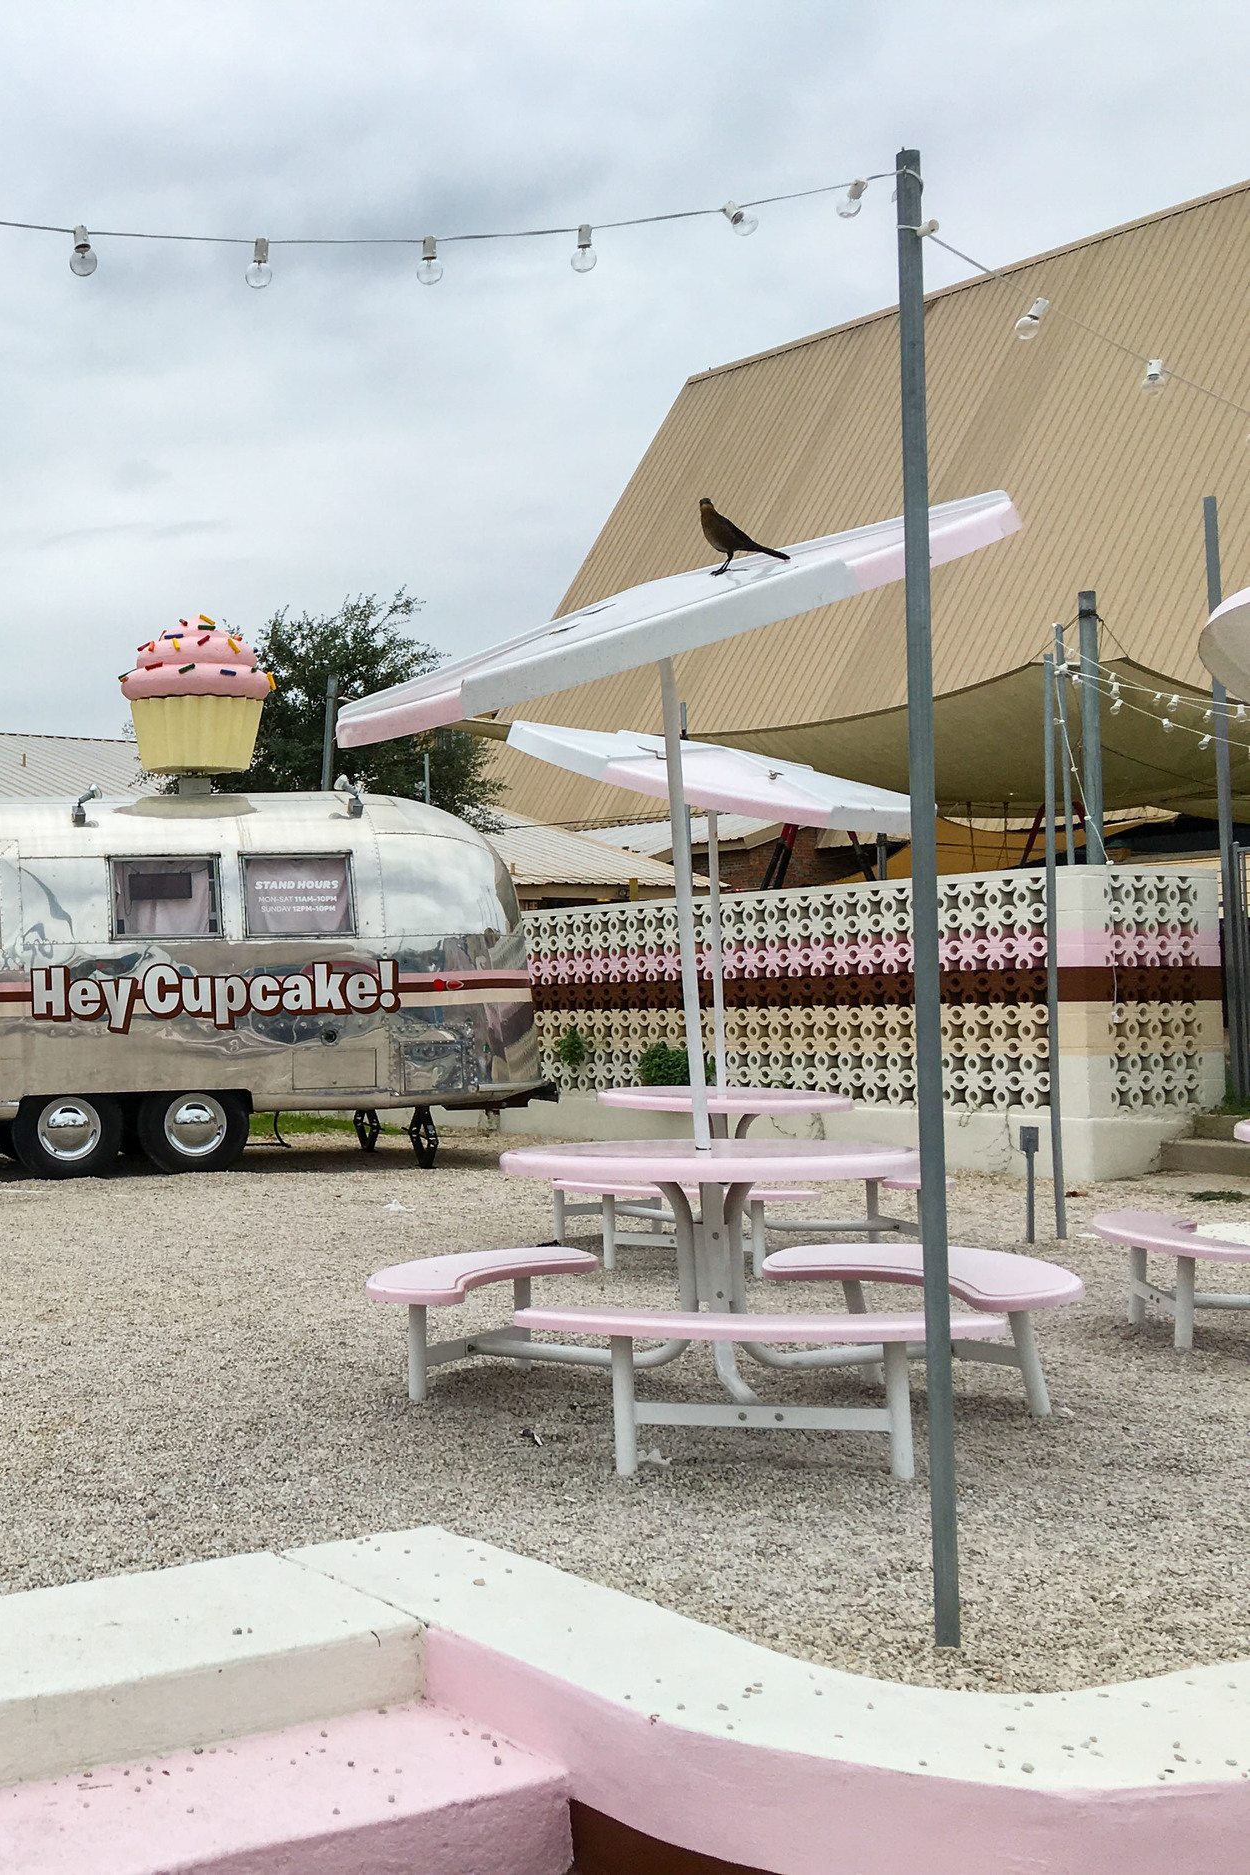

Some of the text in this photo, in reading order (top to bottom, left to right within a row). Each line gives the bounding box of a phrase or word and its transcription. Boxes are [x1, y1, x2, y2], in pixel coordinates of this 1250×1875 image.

[255, 880, 339, 890] STAND HOURS
[258, 895, 293, 903] MON-SAT
[261, 905, 291, 913] SUNDAY
[30, 959, 402, 1034] Hey Cupcake!
